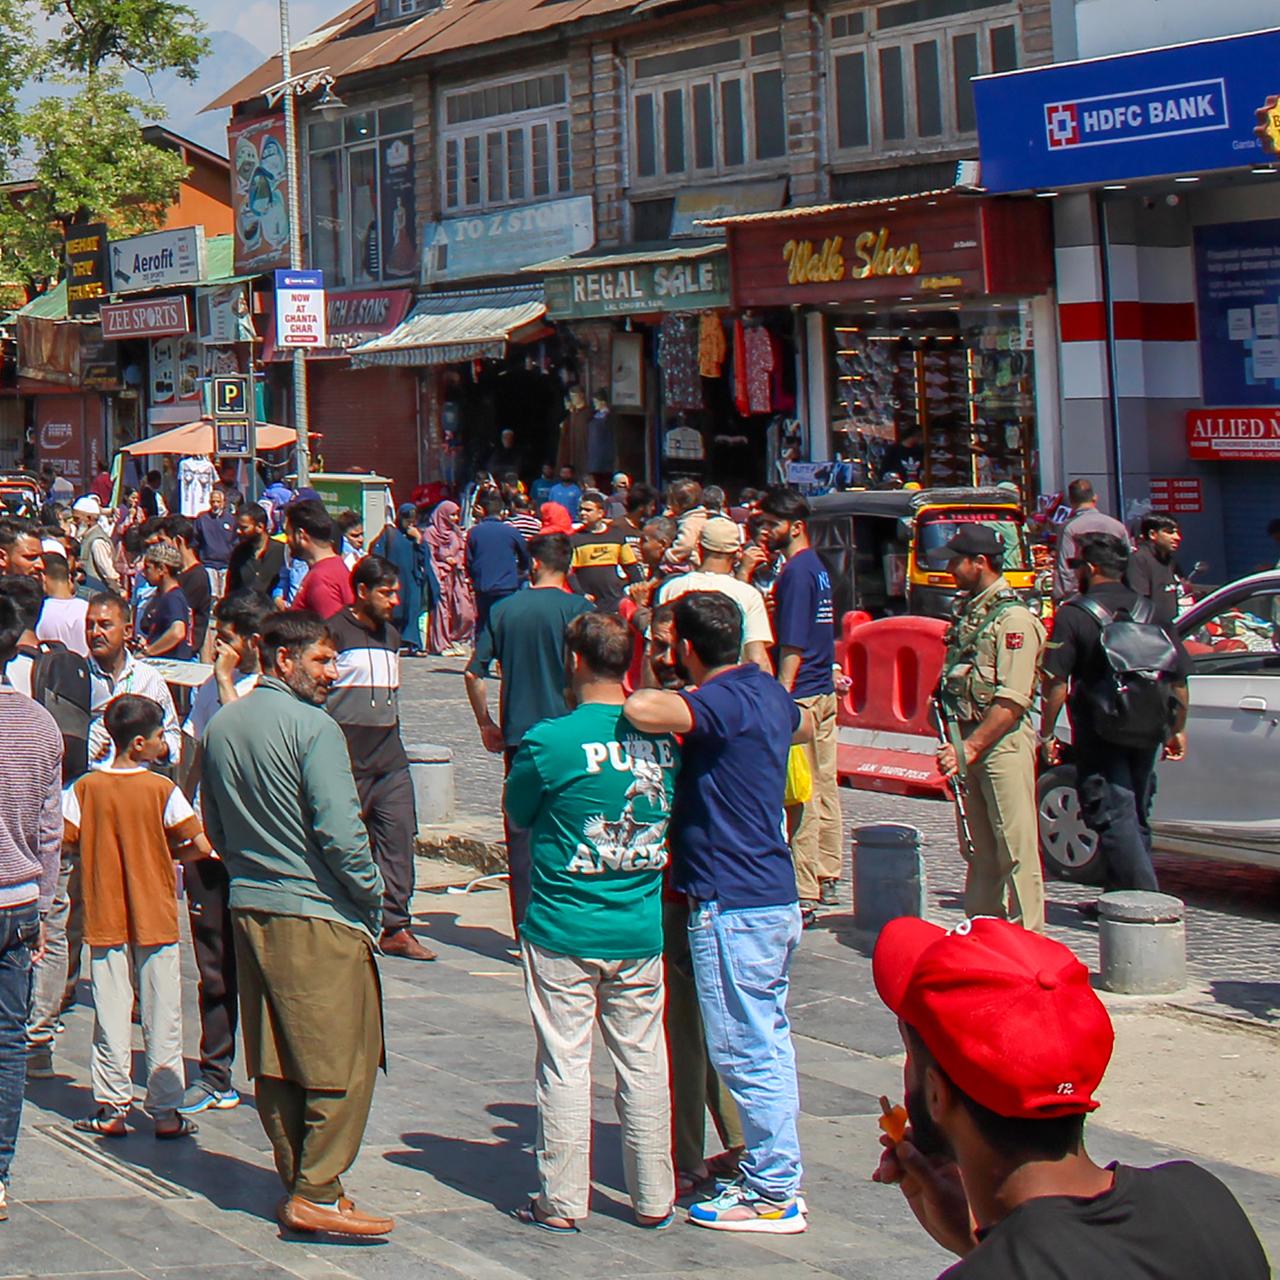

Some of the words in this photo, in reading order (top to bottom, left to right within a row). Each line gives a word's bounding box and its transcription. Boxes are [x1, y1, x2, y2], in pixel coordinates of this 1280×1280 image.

[1083, 105, 1142, 133] HDFC
[1148, 94, 1215, 125] BANK
[432, 225, 448, 245] A
[455, 220, 484, 241] TO
[487, 215, 503, 236] Z
[132, 248, 174, 274] Aerofit
[783, 235, 845, 285] Walk
[852, 227, 922, 279] Shoes
[572, 270, 643, 302] REGAL
[654, 262, 713, 297] SALE
[291, 294, 310, 302] NOW
[296, 305, 306, 313] AT
[356, 298, 390, 324] SONS
[108, 309, 130, 331] ZEE
[132, 304, 179, 329] SPORTS
[284, 314, 318, 324] GHANTA
[290, 324, 313, 333] GHAR
[224, 384, 238, 404] P
[1193, 418, 1265, 438] ALLIED
[581, 739, 675, 774] PURE
[904, 769, 930, 780] POLICE
